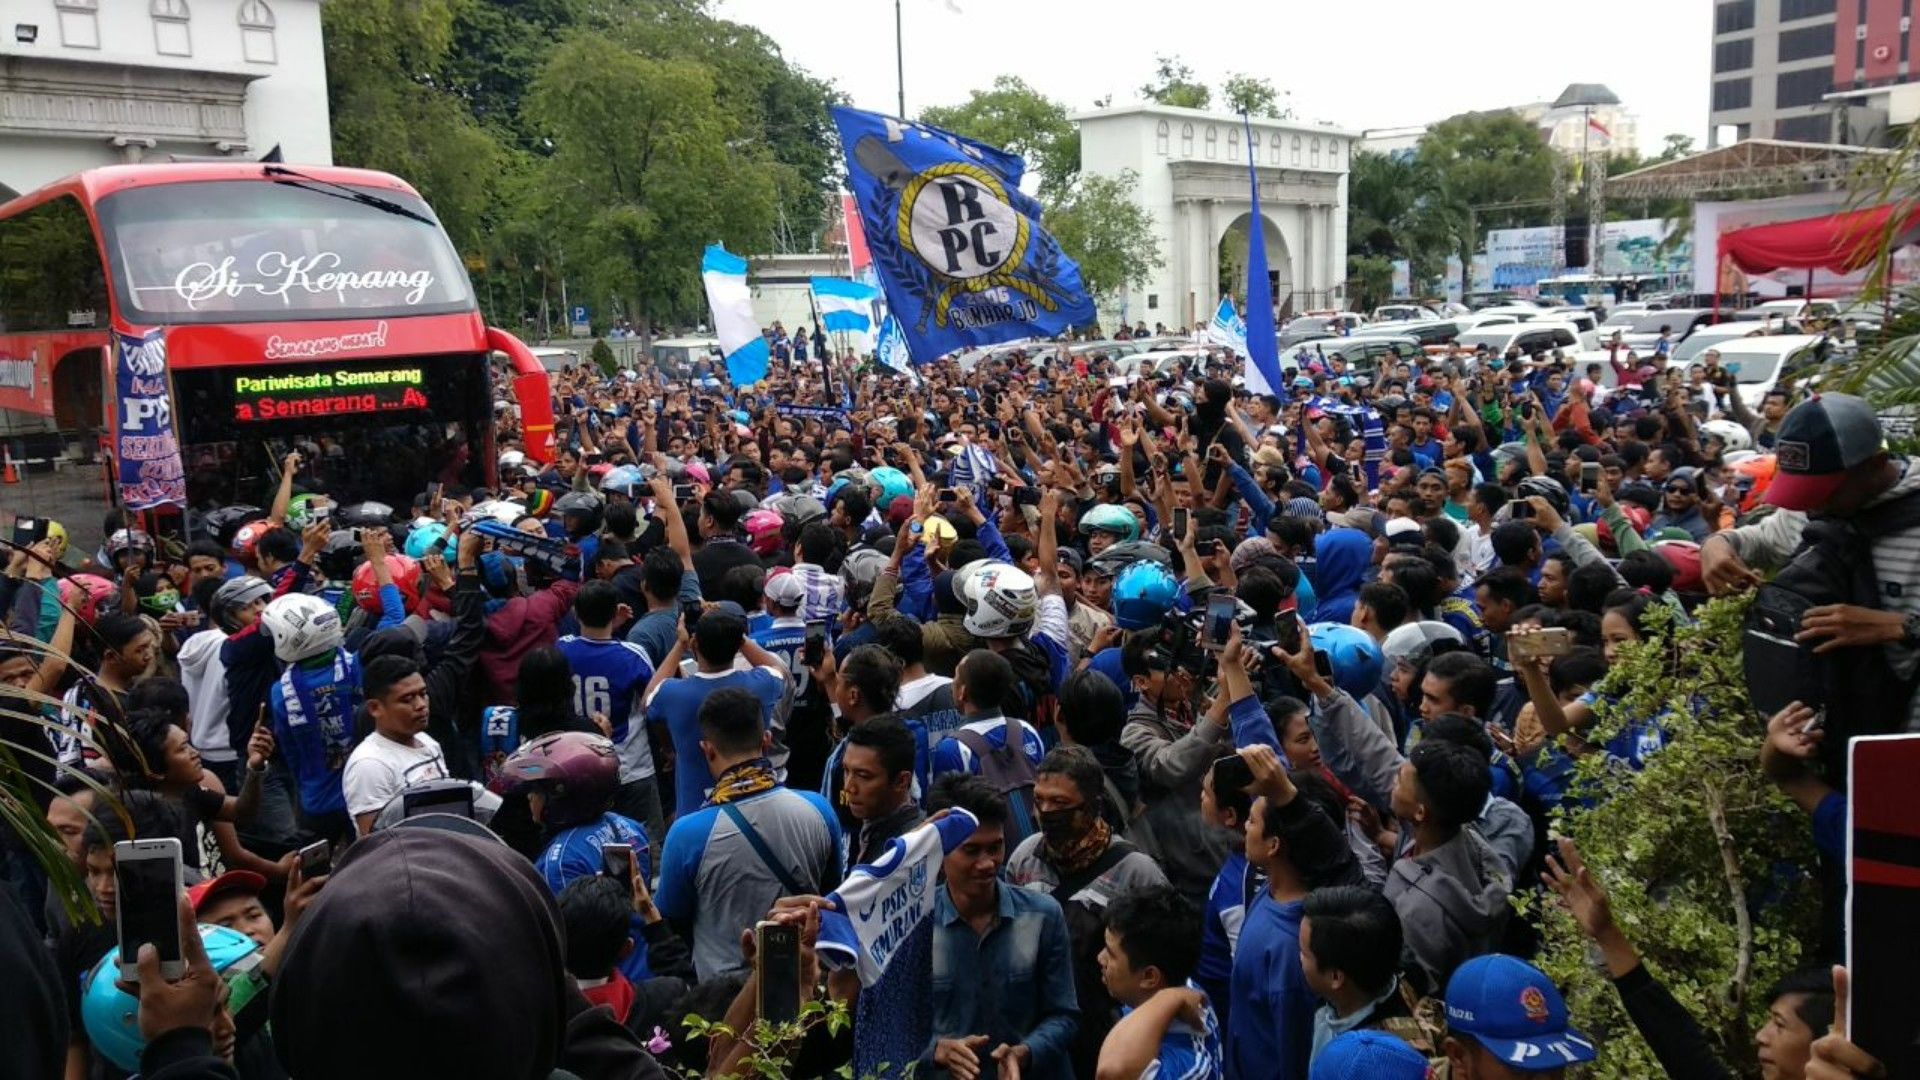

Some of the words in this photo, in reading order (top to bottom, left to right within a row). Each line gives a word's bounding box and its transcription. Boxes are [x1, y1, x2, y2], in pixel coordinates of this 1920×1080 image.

[938, 180, 987, 226] R
[936, 221, 998, 273] PC
[175, 255, 243, 310] Si
[256, 251, 435, 306] Kenang
[575, 306, 585, 321] P
[236, 372, 332, 394] Pariwisata
[335, 369, 421, 386] Semarang
[235, 403, 253, 421] a
[258, 394, 376, 419] Semarang
[572, 674, 611, 720] 16
[881, 882, 908, 923] PSIS
